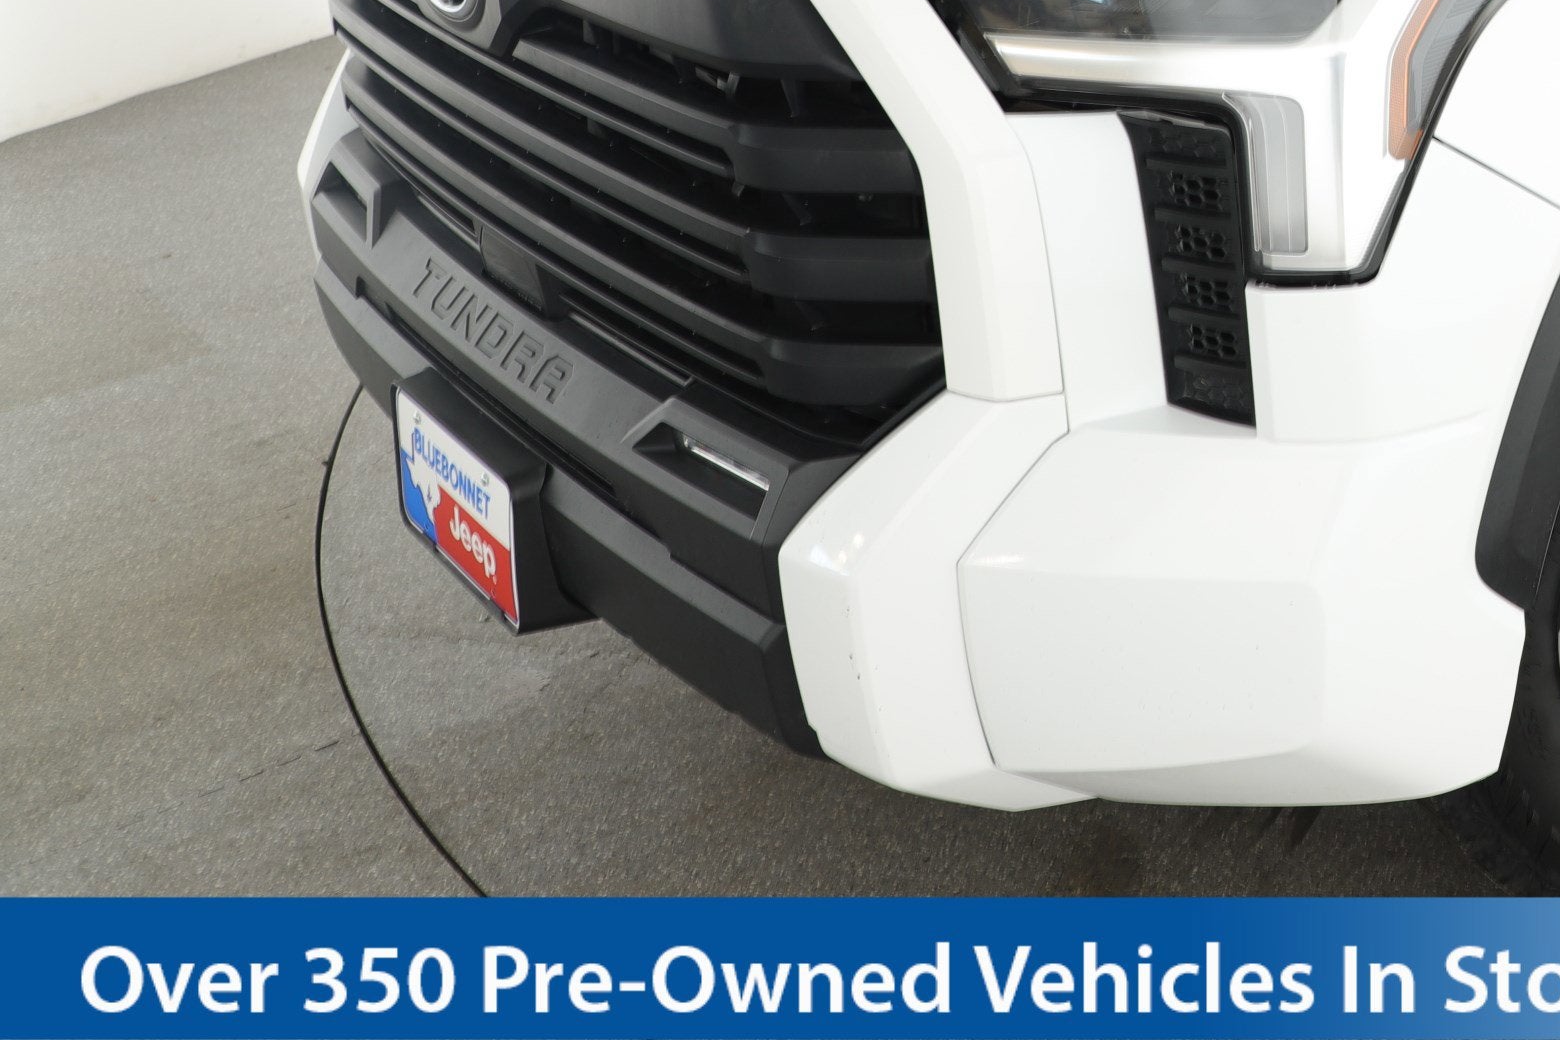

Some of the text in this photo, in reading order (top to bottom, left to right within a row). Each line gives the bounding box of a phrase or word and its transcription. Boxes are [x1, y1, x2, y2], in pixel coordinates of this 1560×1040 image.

[410, 257, 574, 405] TUNDRA
[413, 427, 491, 520] BLUEBONNET
[449, 503, 498, 579] Jeep
